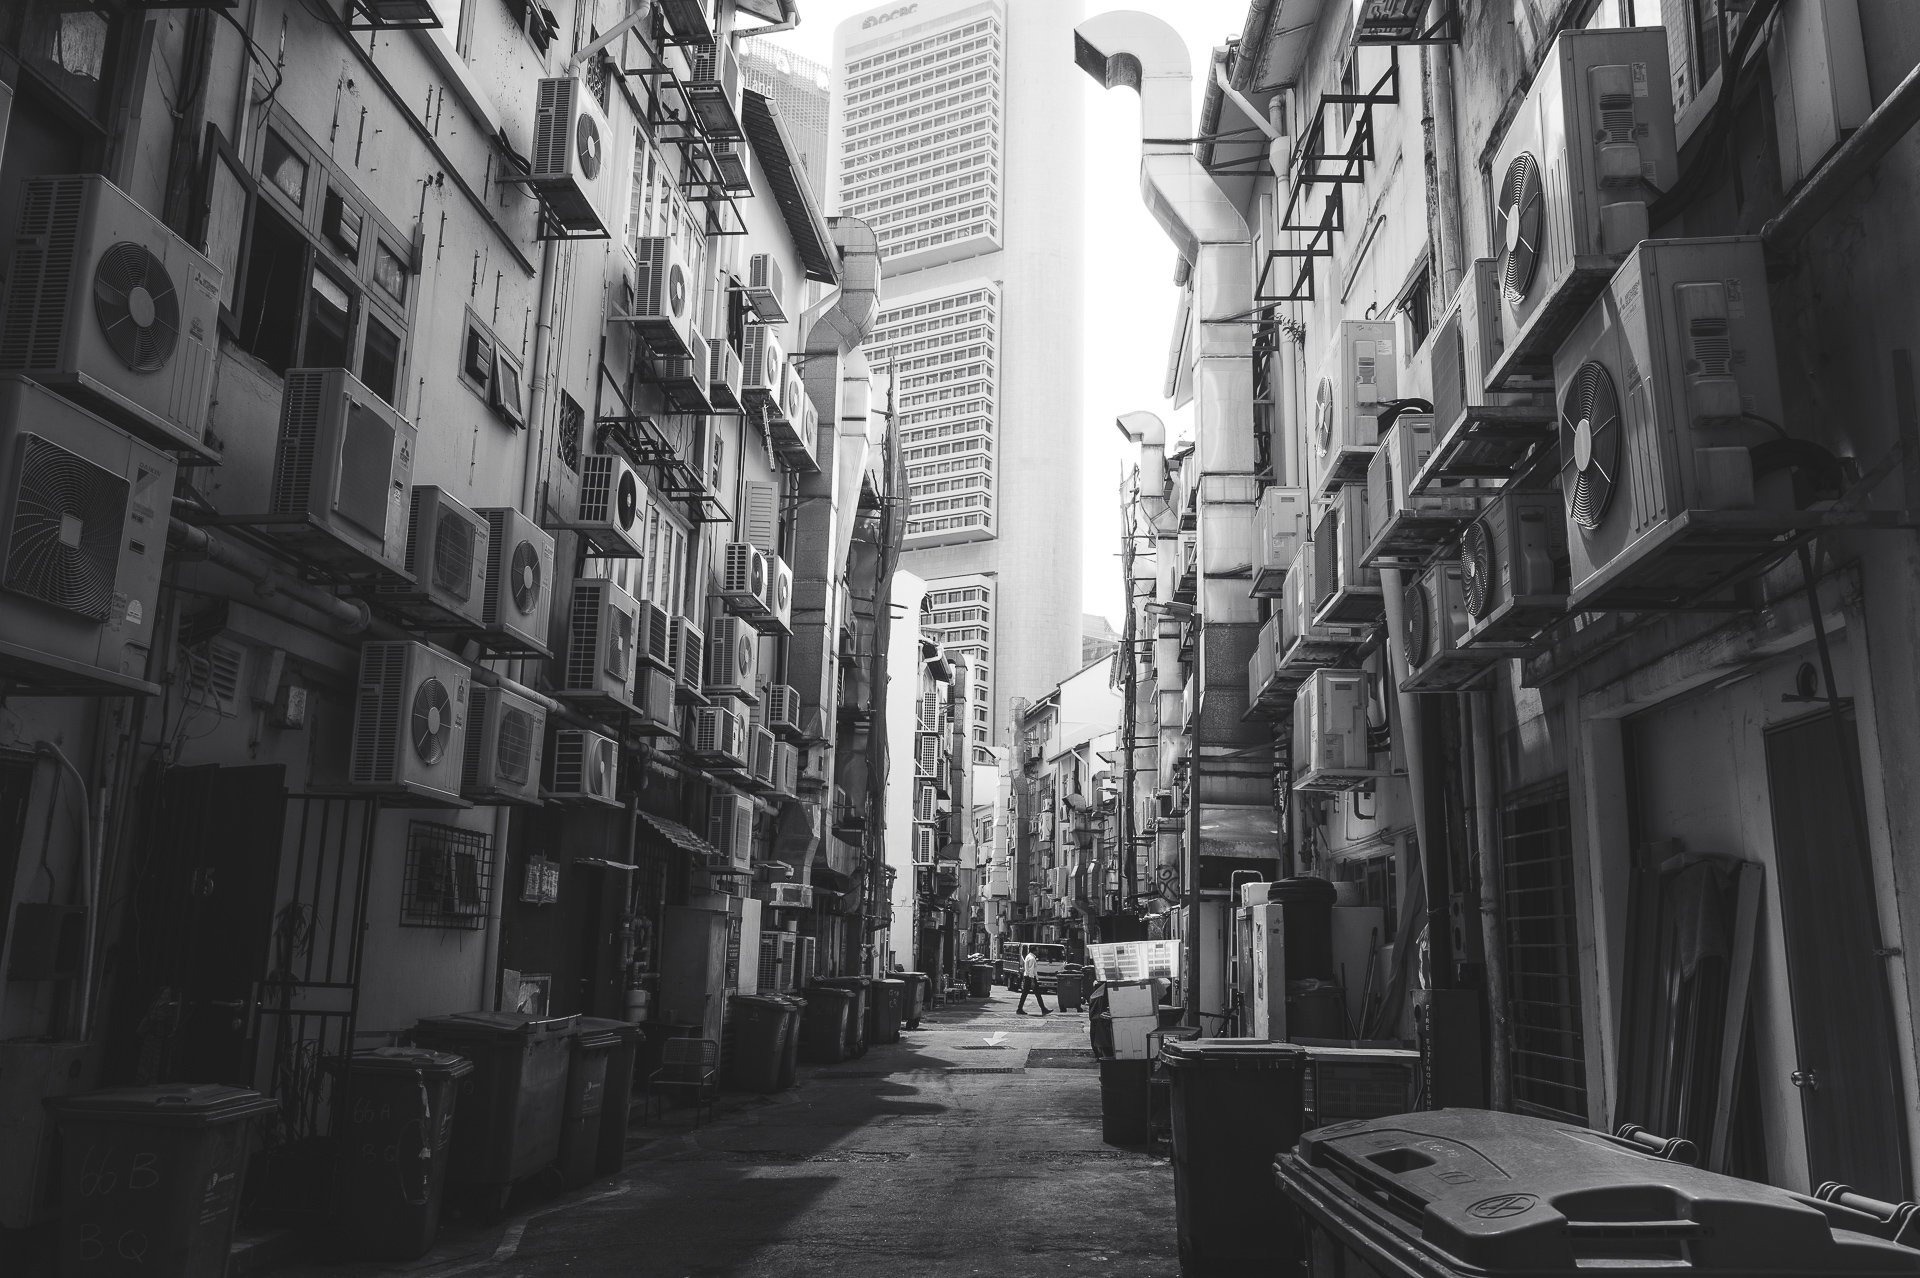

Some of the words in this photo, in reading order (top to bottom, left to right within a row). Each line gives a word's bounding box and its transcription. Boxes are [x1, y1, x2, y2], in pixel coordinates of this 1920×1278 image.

[139, 462, 162, 477] DAIKIN
[353, 1096, 375, 1123] 66
[79, 1144, 118, 1198] 66
[129, 1152, 160, 1190] B
